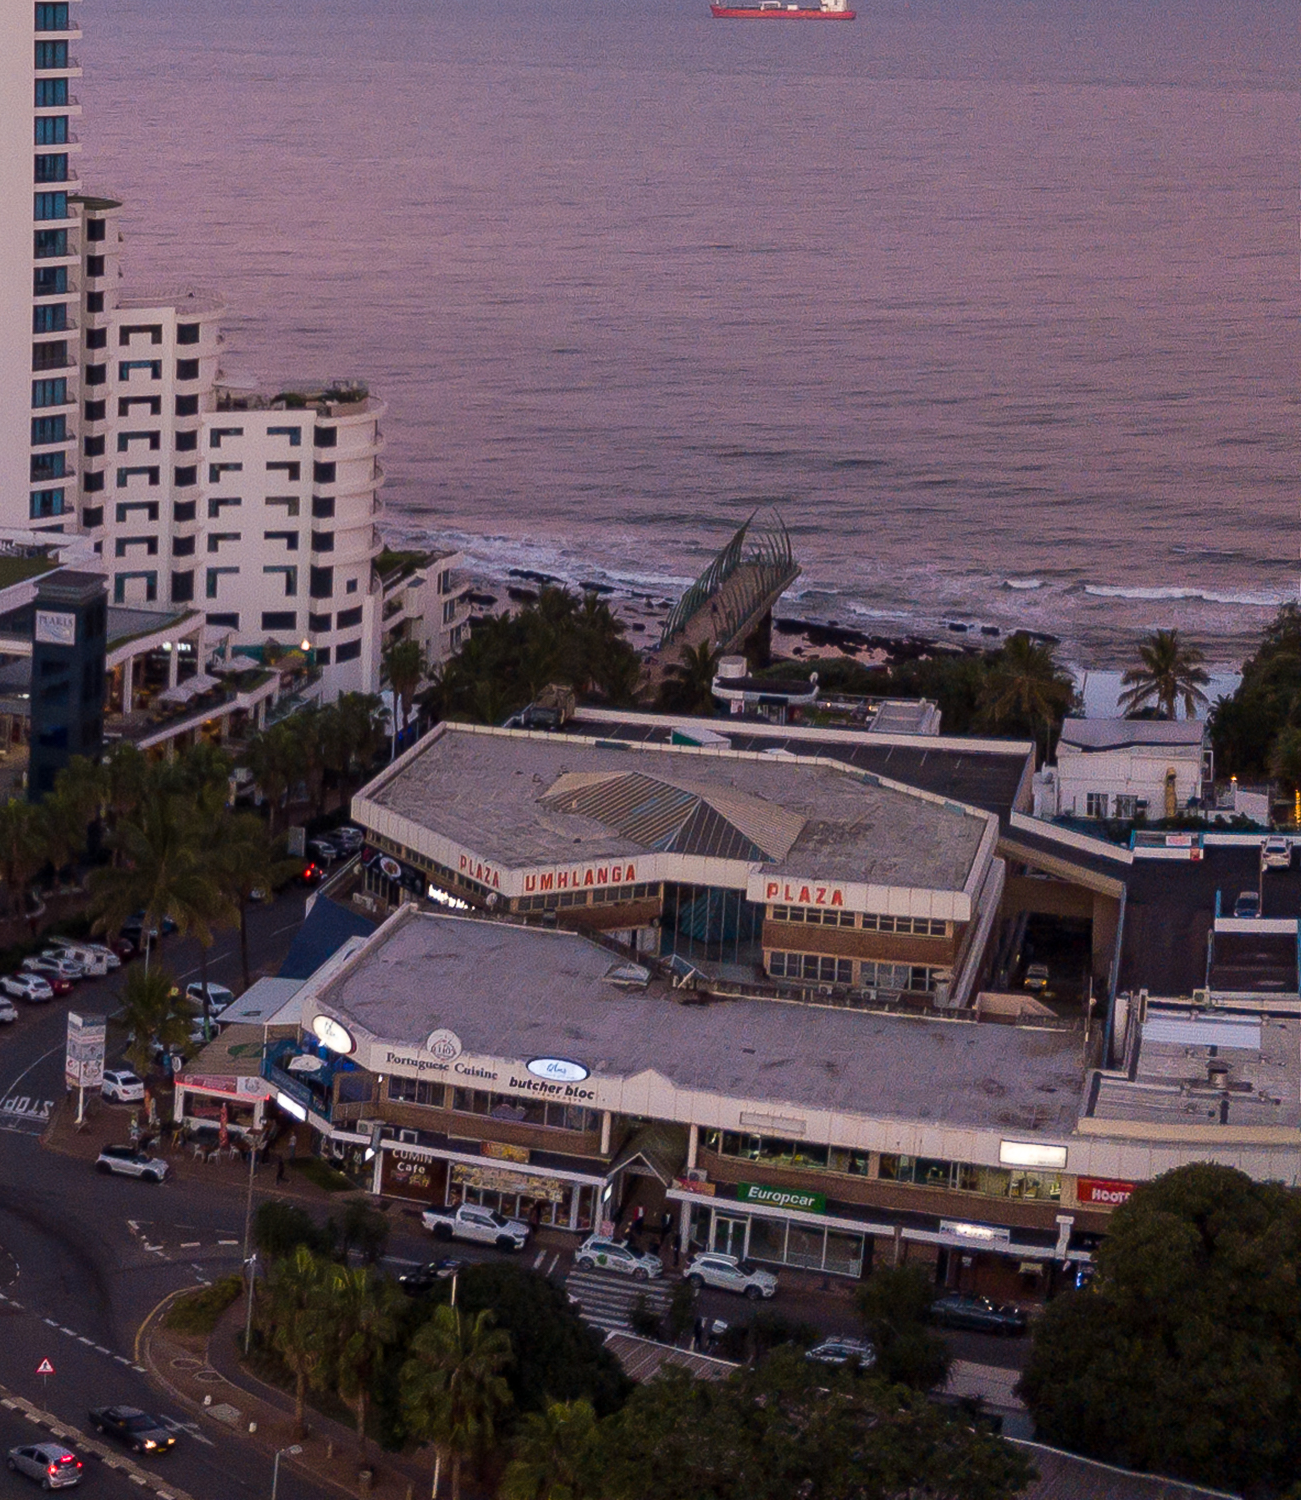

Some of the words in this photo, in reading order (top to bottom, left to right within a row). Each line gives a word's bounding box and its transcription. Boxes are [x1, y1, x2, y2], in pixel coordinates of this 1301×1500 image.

[459, 854, 500, 889] PLAZA
[525, 864, 636, 892] UMHLANGA
[766, 882, 844, 907] PLAZA
[387, 1052, 449, 1071] Portuguese
[454, 1062, 498, 1080] Cuisine
[509, 1077, 563, 1094] butcher
[565, 1085, 595, 1100] bloc
[392, 1149, 432, 1164] CUMIN
[397, 1161, 425, 1175] Cafe
[748, 1186, 815, 1206] Europcar
